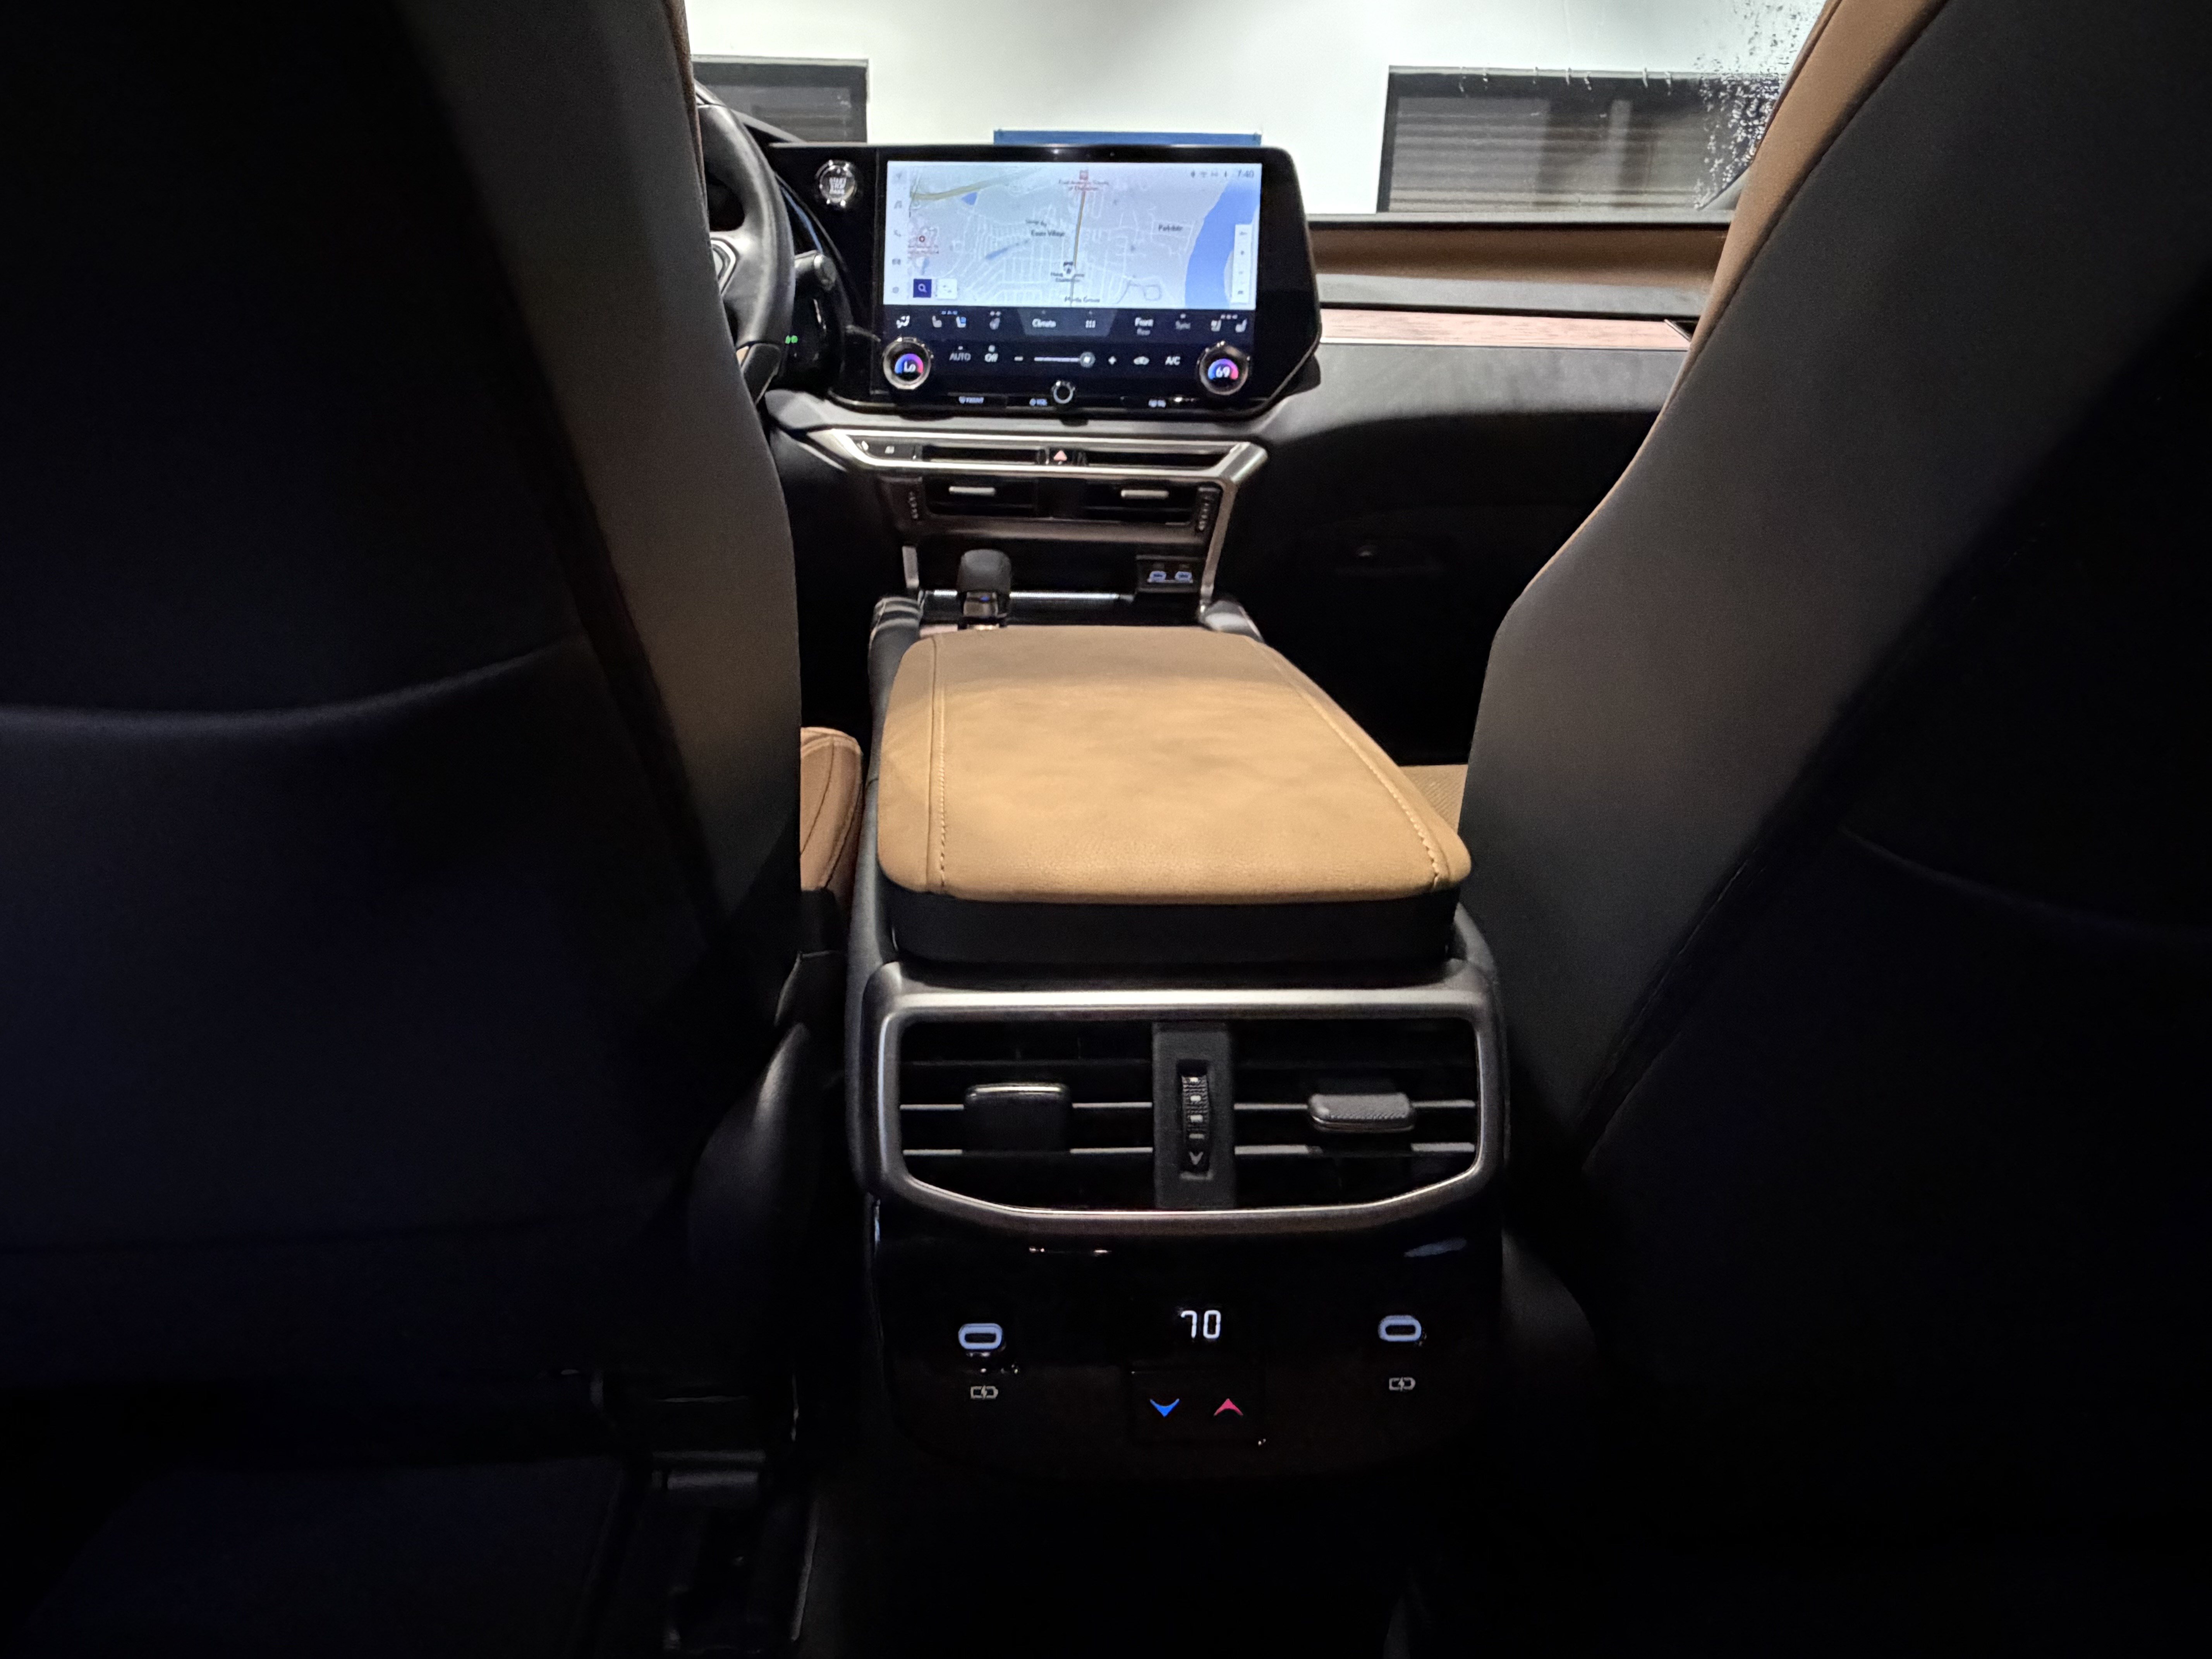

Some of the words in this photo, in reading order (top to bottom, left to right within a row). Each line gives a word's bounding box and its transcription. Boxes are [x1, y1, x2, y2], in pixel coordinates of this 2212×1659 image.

[949, 352, 971, 361] AUTO
[984, 353, 998, 362] Off
[1165, 356, 1181, 366] A/C
[1215, 366, 1230, 378] 69
[1181, 1310, 1221, 1339] 70
